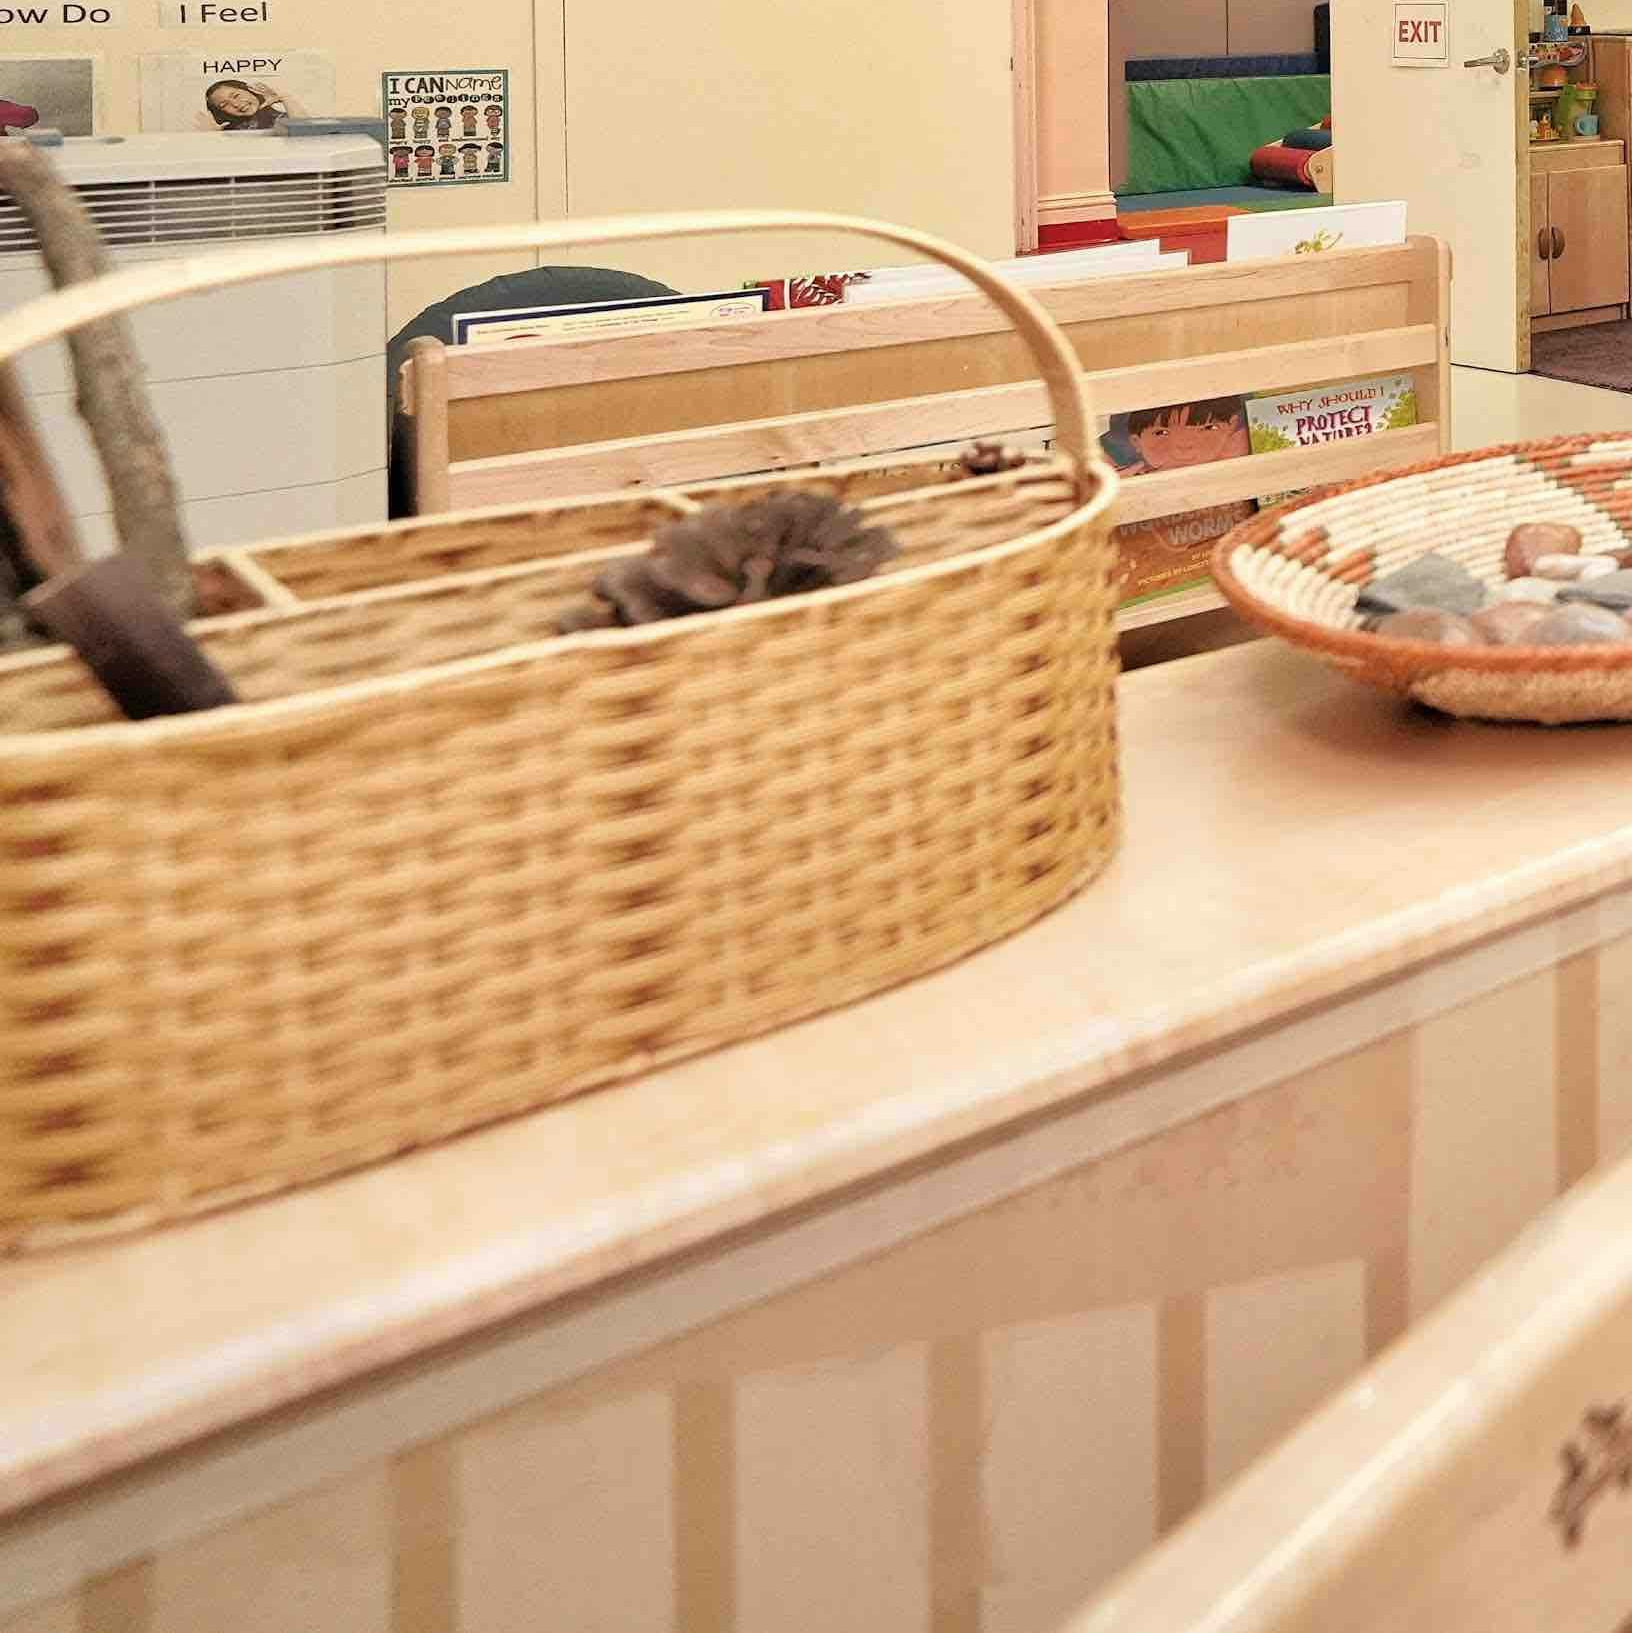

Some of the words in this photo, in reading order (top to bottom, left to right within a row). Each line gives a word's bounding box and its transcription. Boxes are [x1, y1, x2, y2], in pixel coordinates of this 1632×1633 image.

[62, 4, 111, 24] Do
[180, 4, 186, 24] I
[201, 1, 268, 24] Feel
[1399, 20, 1442, 43] EXIT
[203, 58, 282, 74] HAPPY
[389, 78, 400, 94] I
[404, 77, 444, 94] CAN
[389, 97, 410, 108] my
[1277, 399, 1313, 416] WHY
[1318, 387, 1377, 410] SHOULD
[1296, 405, 1373, 435] PROTECT
